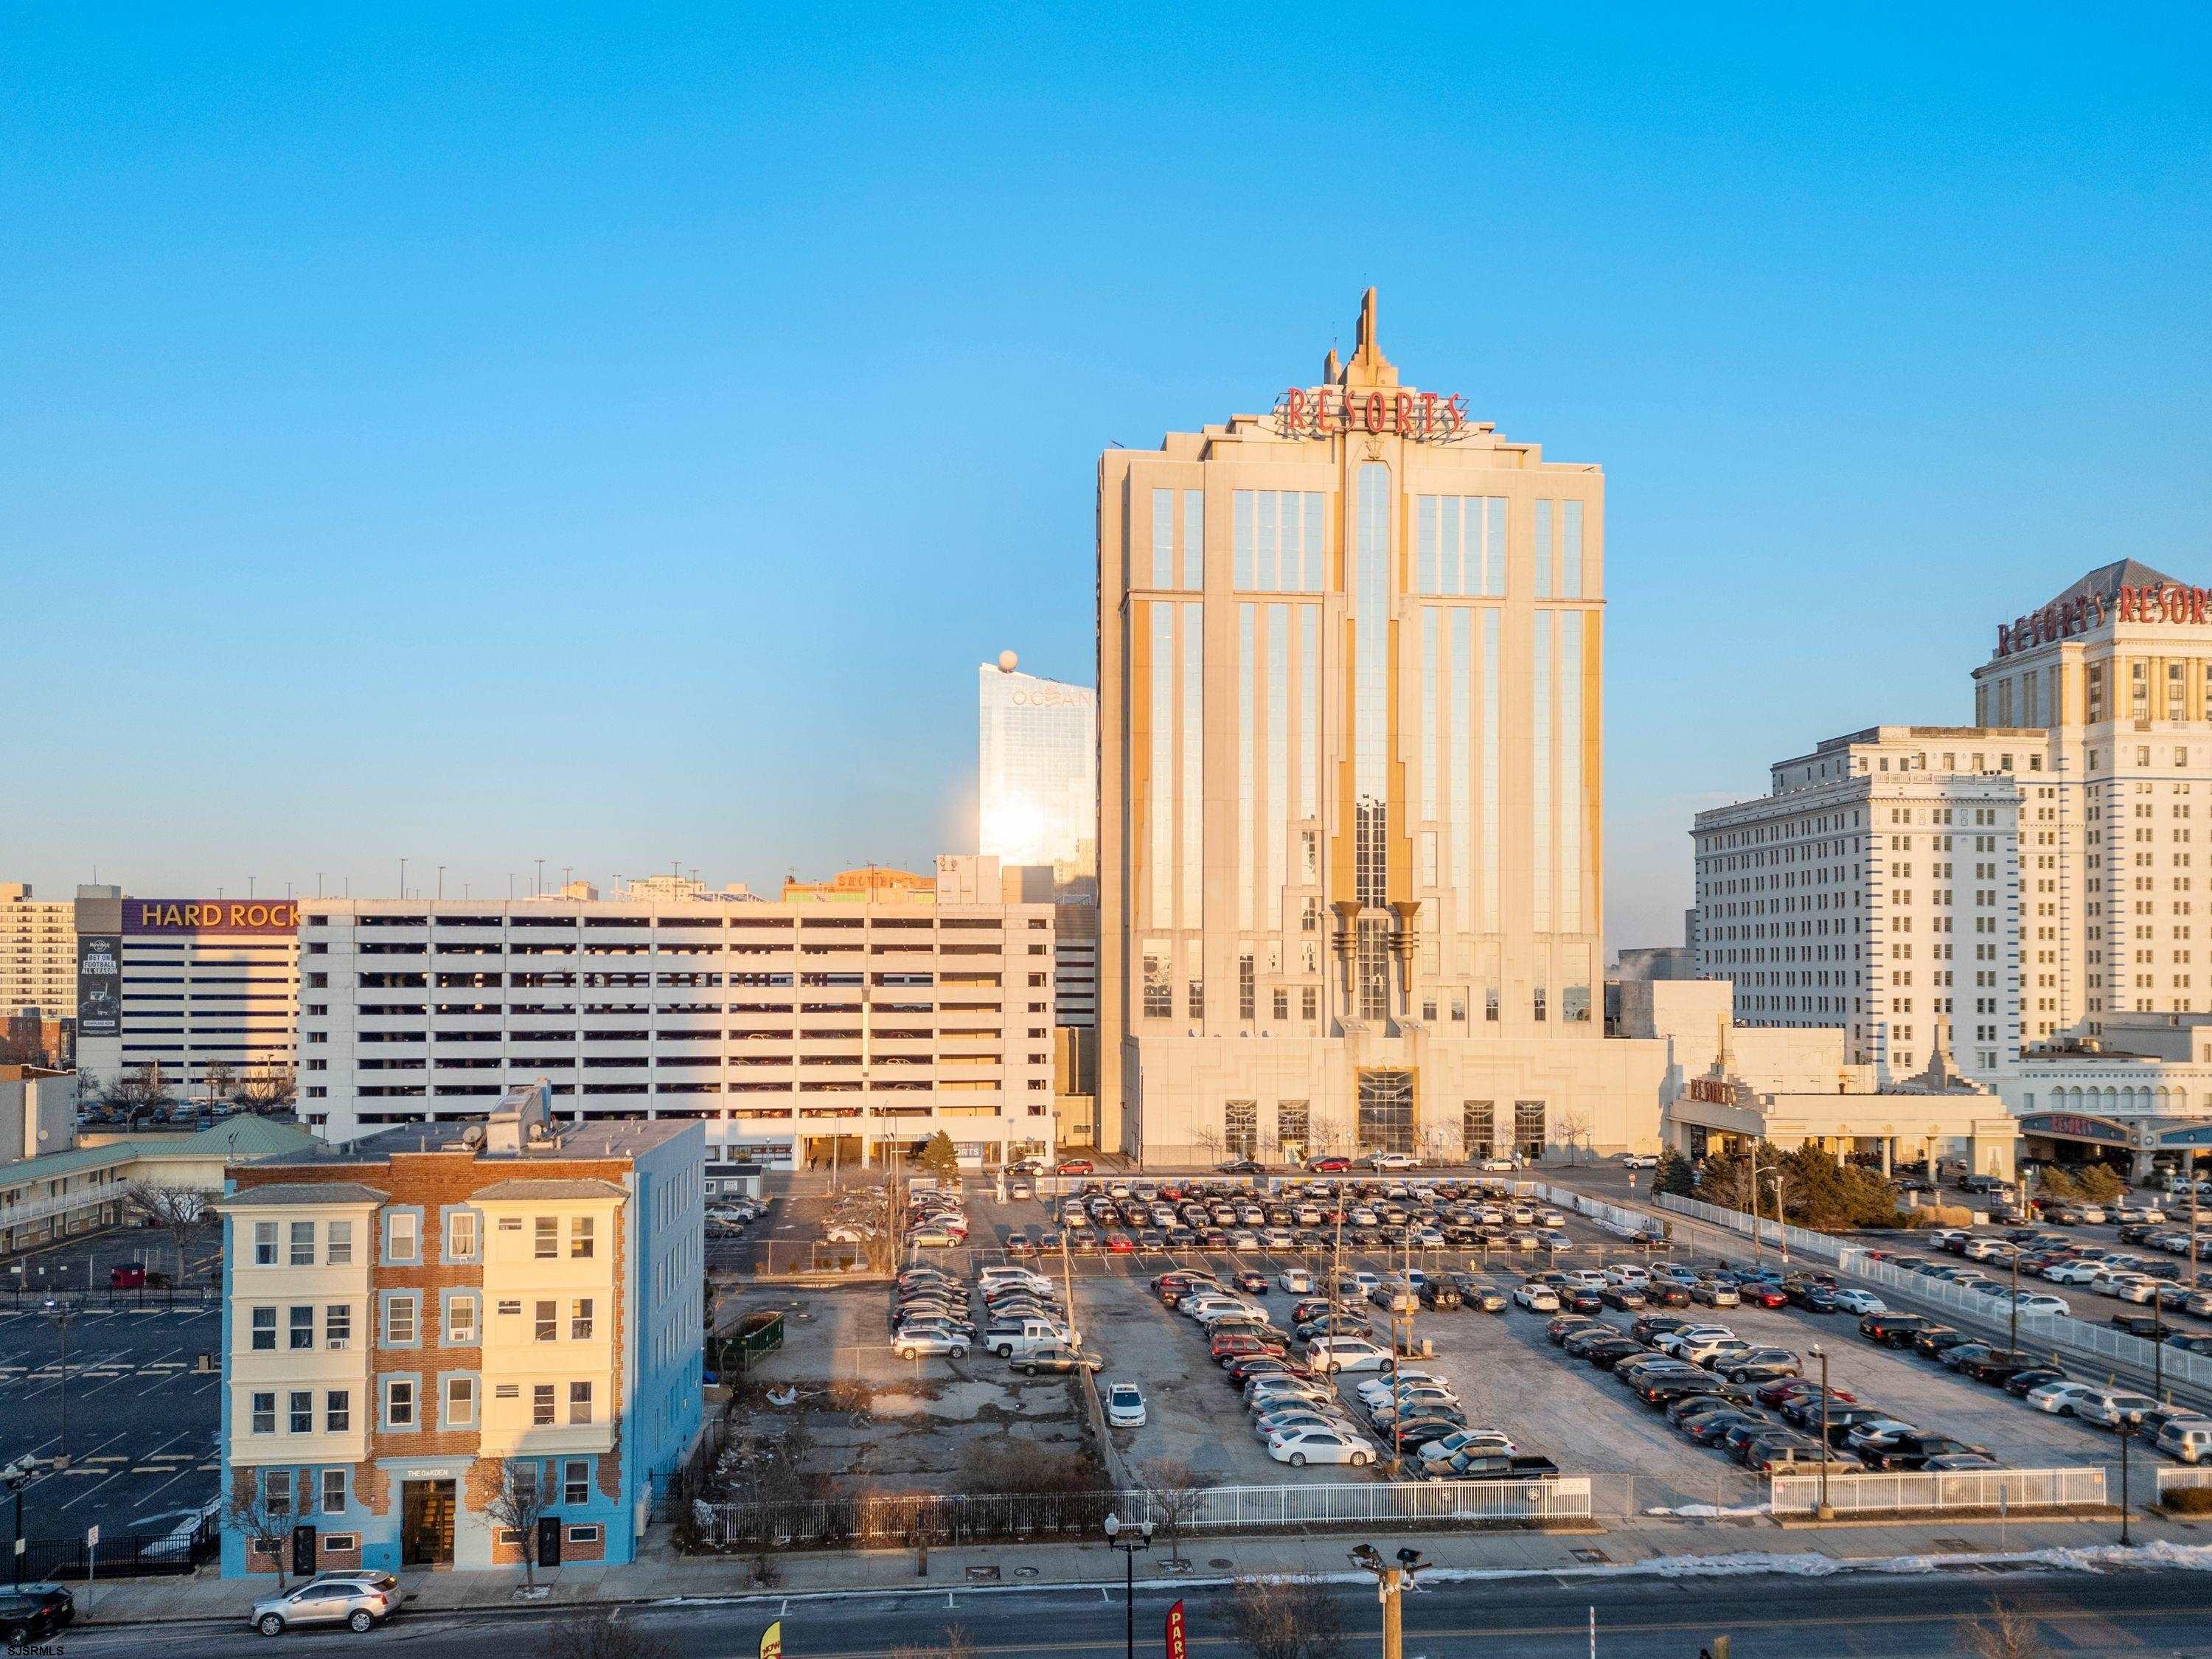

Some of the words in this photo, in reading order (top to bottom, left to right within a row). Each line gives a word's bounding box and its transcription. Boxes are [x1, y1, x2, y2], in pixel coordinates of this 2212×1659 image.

[1288, 389, 1461, 433] RESORTS
[1997, 591, 2105, 657] RESORTS
[2118, 585, 2212, 625] RESOR
[142, 904, 222, 926] HARD
[230, 904, 301, 927] ROCK
[955, 1148, 979, 1156] ORTS
